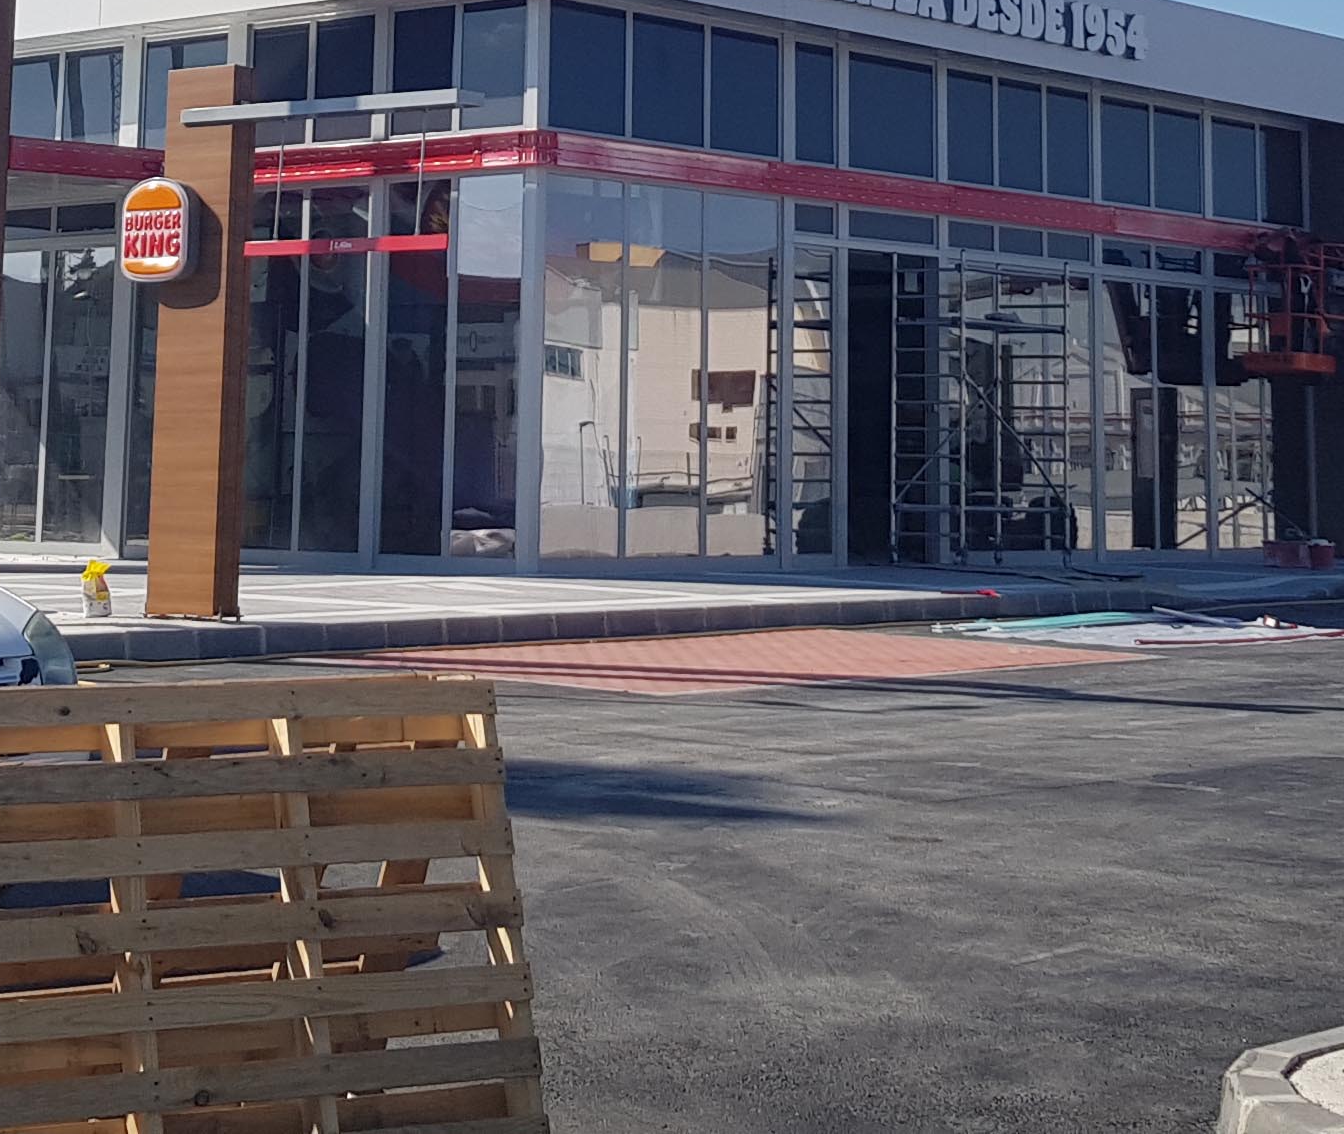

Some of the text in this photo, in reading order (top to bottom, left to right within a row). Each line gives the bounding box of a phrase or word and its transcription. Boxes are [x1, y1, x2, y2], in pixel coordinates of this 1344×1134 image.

[1071, 0, 1149, 61] 1954
[125, 211, 181, 232] BURGER
[124, 230, 181, 258] KING
